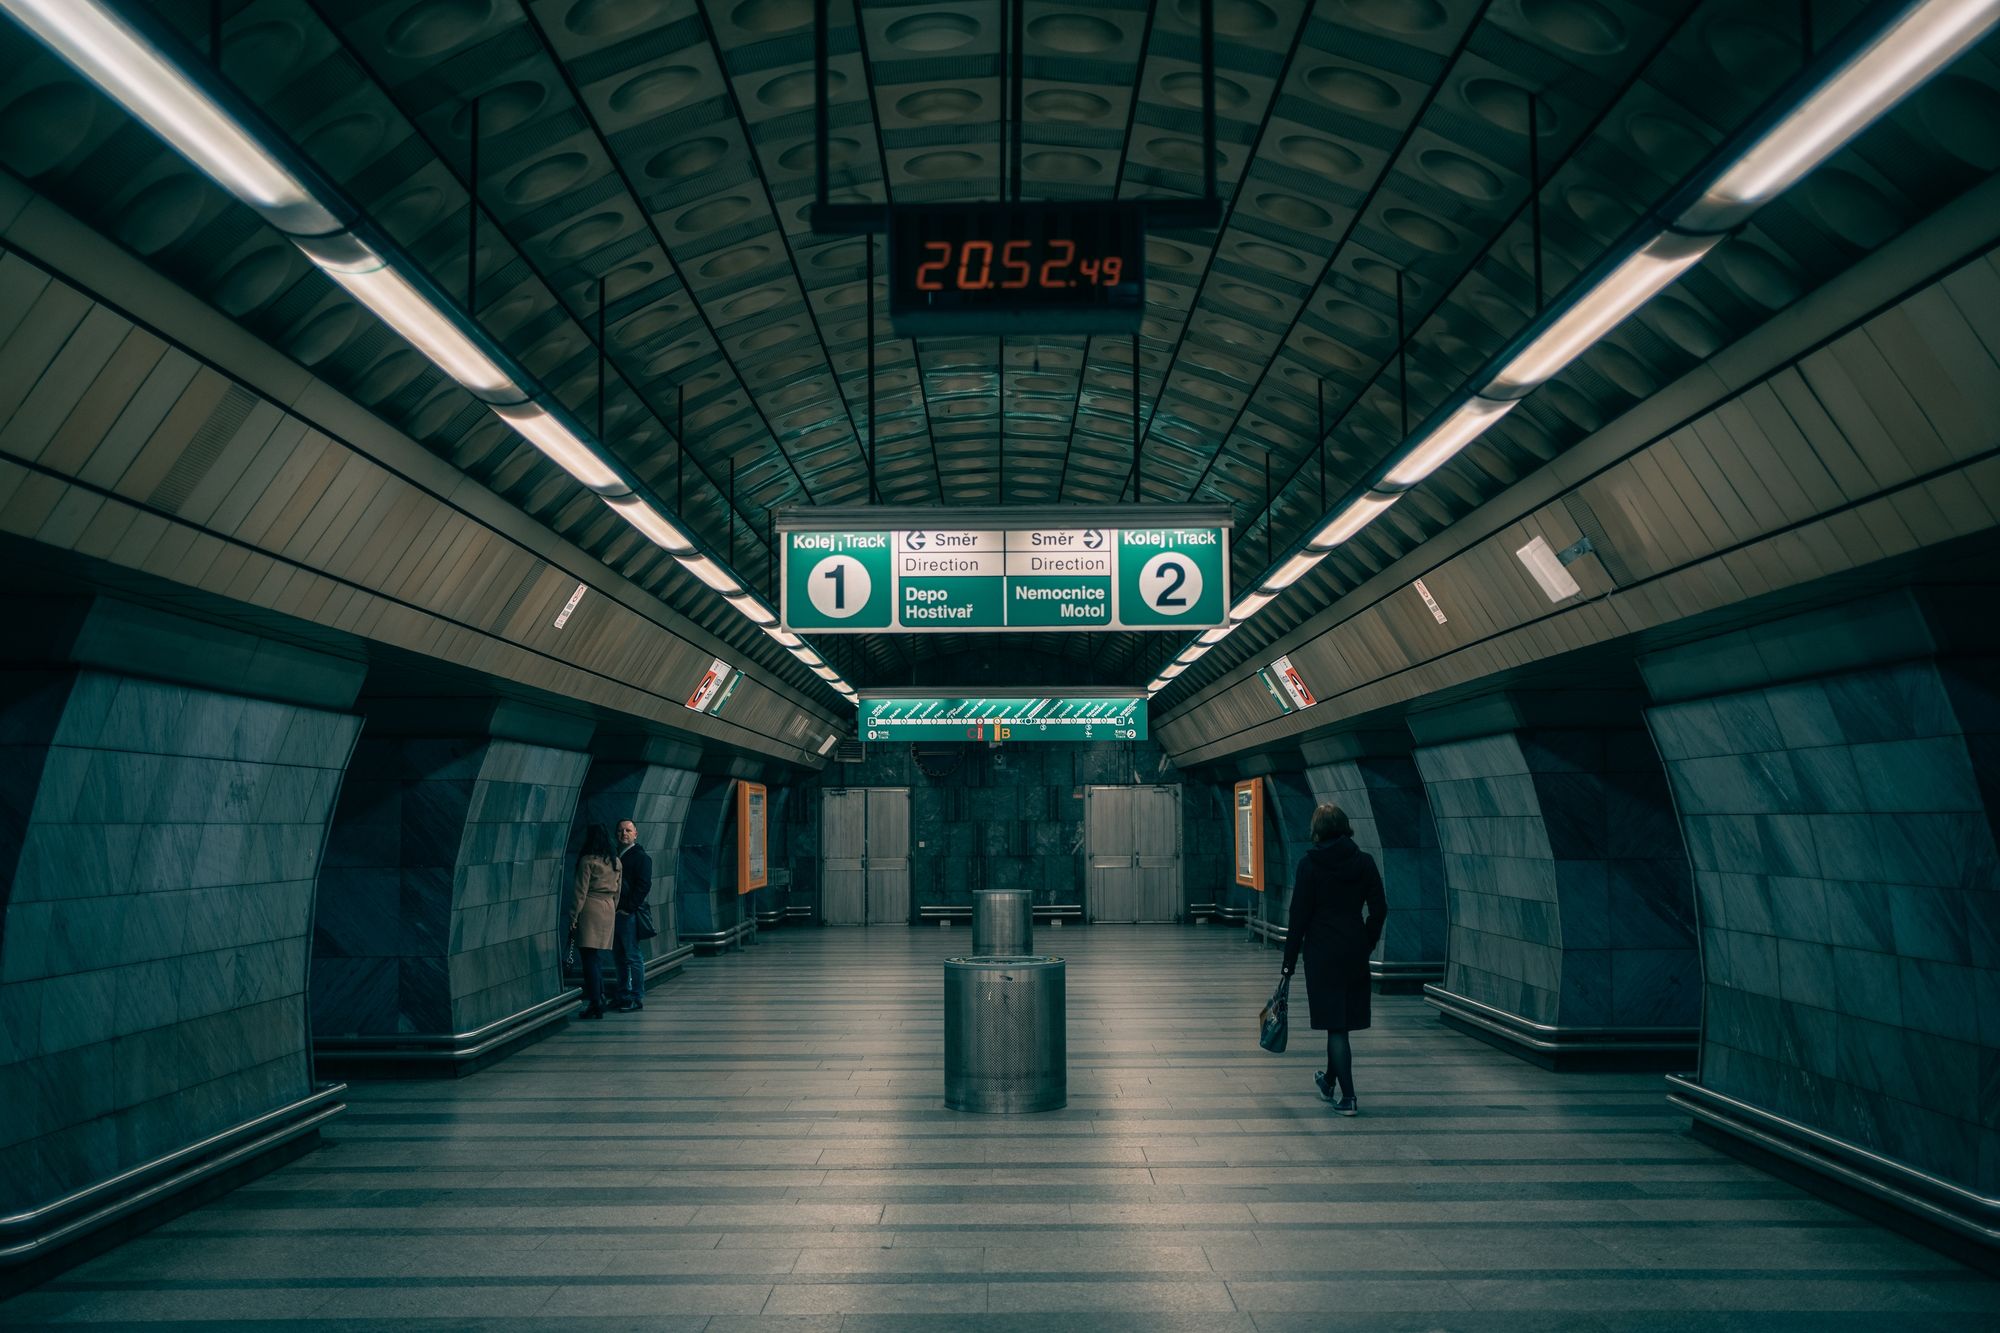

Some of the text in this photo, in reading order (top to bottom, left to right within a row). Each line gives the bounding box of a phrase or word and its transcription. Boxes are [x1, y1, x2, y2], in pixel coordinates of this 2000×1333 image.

[793, 533, 886, 552] Kolej Track
[935, 532, 979, 547] Směr
[1031, 532, 1075, 546] Směr
[1123, 530, 1216, 549] Kolej Track
[905, 558, 979, 572] Direction
[1031, 557, 1105, 571] Direction
[824, 564, 845, 609] 1
[1155, 561, 1187, 606] 2
[905, 587, 948, 604] Depo
[1016, 586, 1105, 600] Nemocnice
[905, 603, 974, 619] Hostivař
[1060, 603, 1105, 618] Motol
[1127, 717, 1135, 725] A
[966, 727, 977, 739] C
[1001, 728, 1011, 739] B
[1128, 730, 1134, 738] 2
